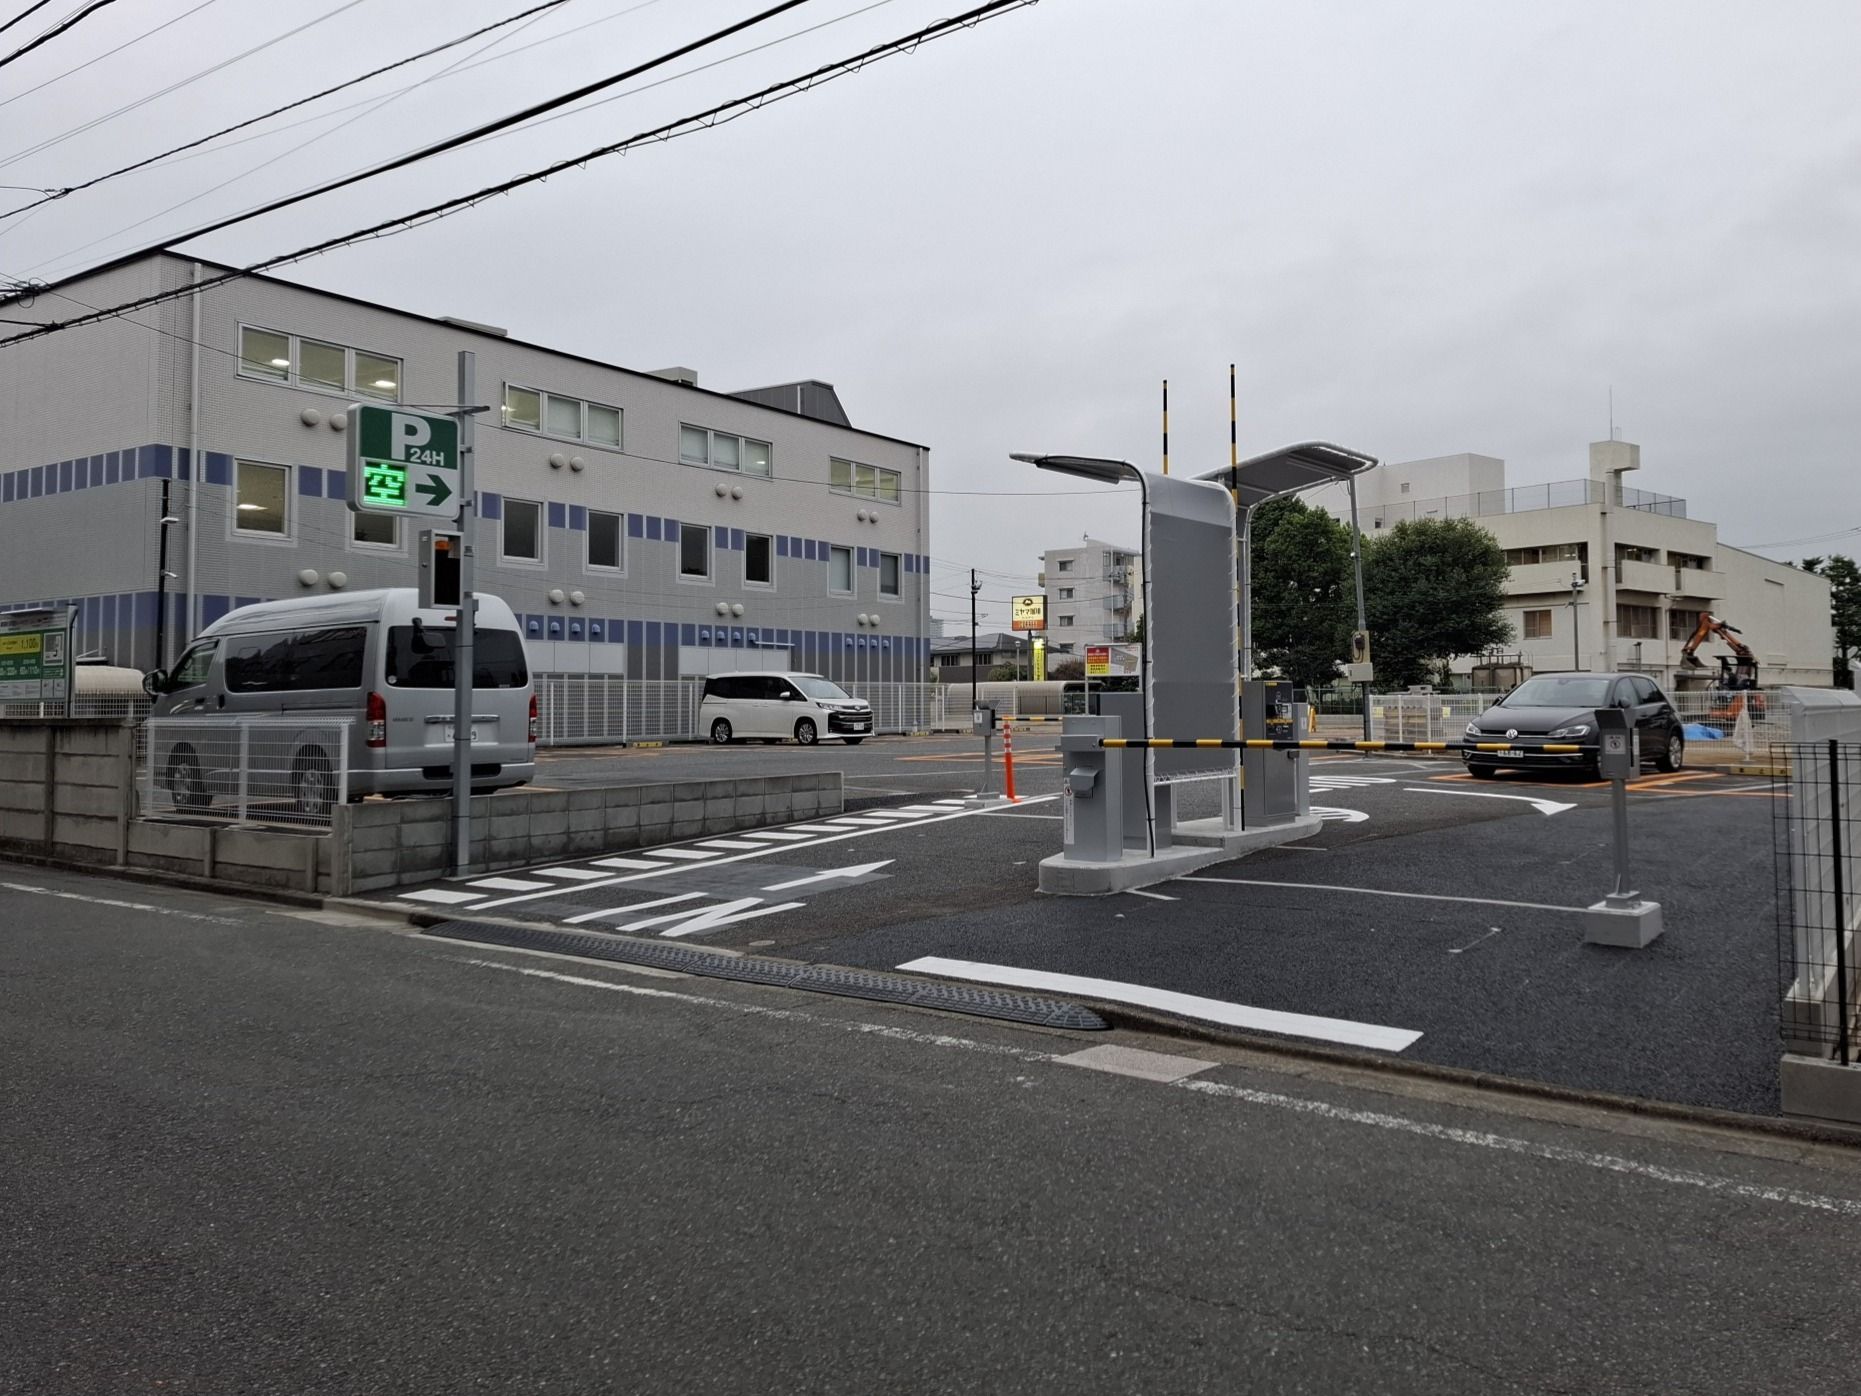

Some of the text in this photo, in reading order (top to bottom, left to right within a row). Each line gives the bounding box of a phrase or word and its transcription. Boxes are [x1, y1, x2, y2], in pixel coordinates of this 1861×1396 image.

[391, 412, 432, 461] P
[410, 447, 445, 467] 24H
[363, 463, 407, 507] 空
